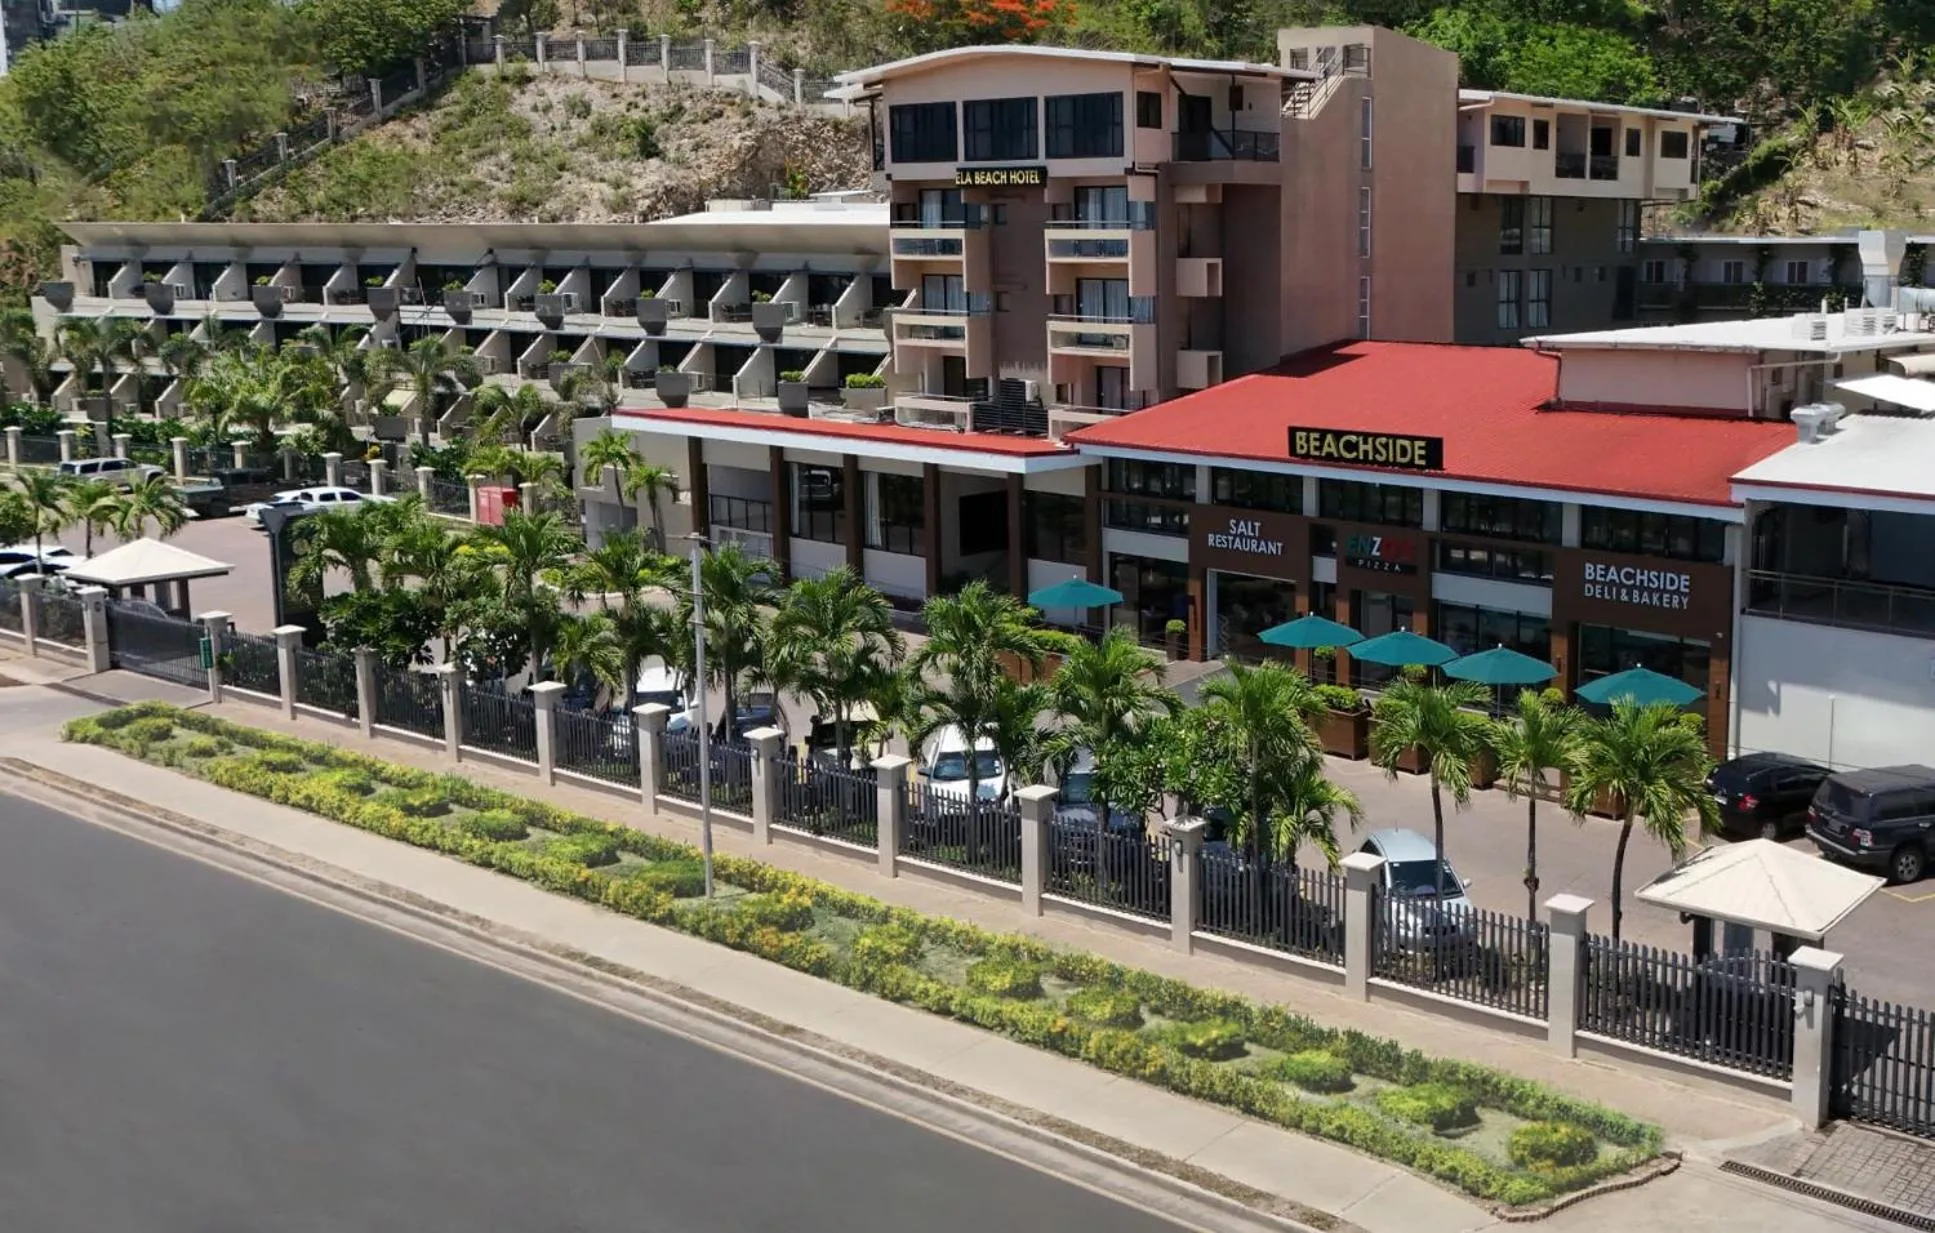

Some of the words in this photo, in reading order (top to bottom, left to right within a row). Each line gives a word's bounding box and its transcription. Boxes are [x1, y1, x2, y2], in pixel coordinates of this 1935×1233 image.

[975, 170, 1007, 184] BEACH
[1010, 170, 1040, 184] HOTEL
[1295, 431, 1427, 465] BEACHSIDE
[1229, 519, 1262, 537] SALT
[1208, 533, 1284, 556] RESTAURANT
[1358, 559, 1402, 572] PIZZA
[1584, 562, 1690, 593] BEACHSIDE
[1584, 583, 1616, 600] DELI
[1620, 588, 1629, 601] &
[1632, 590, 1689, 609] BAKERY
